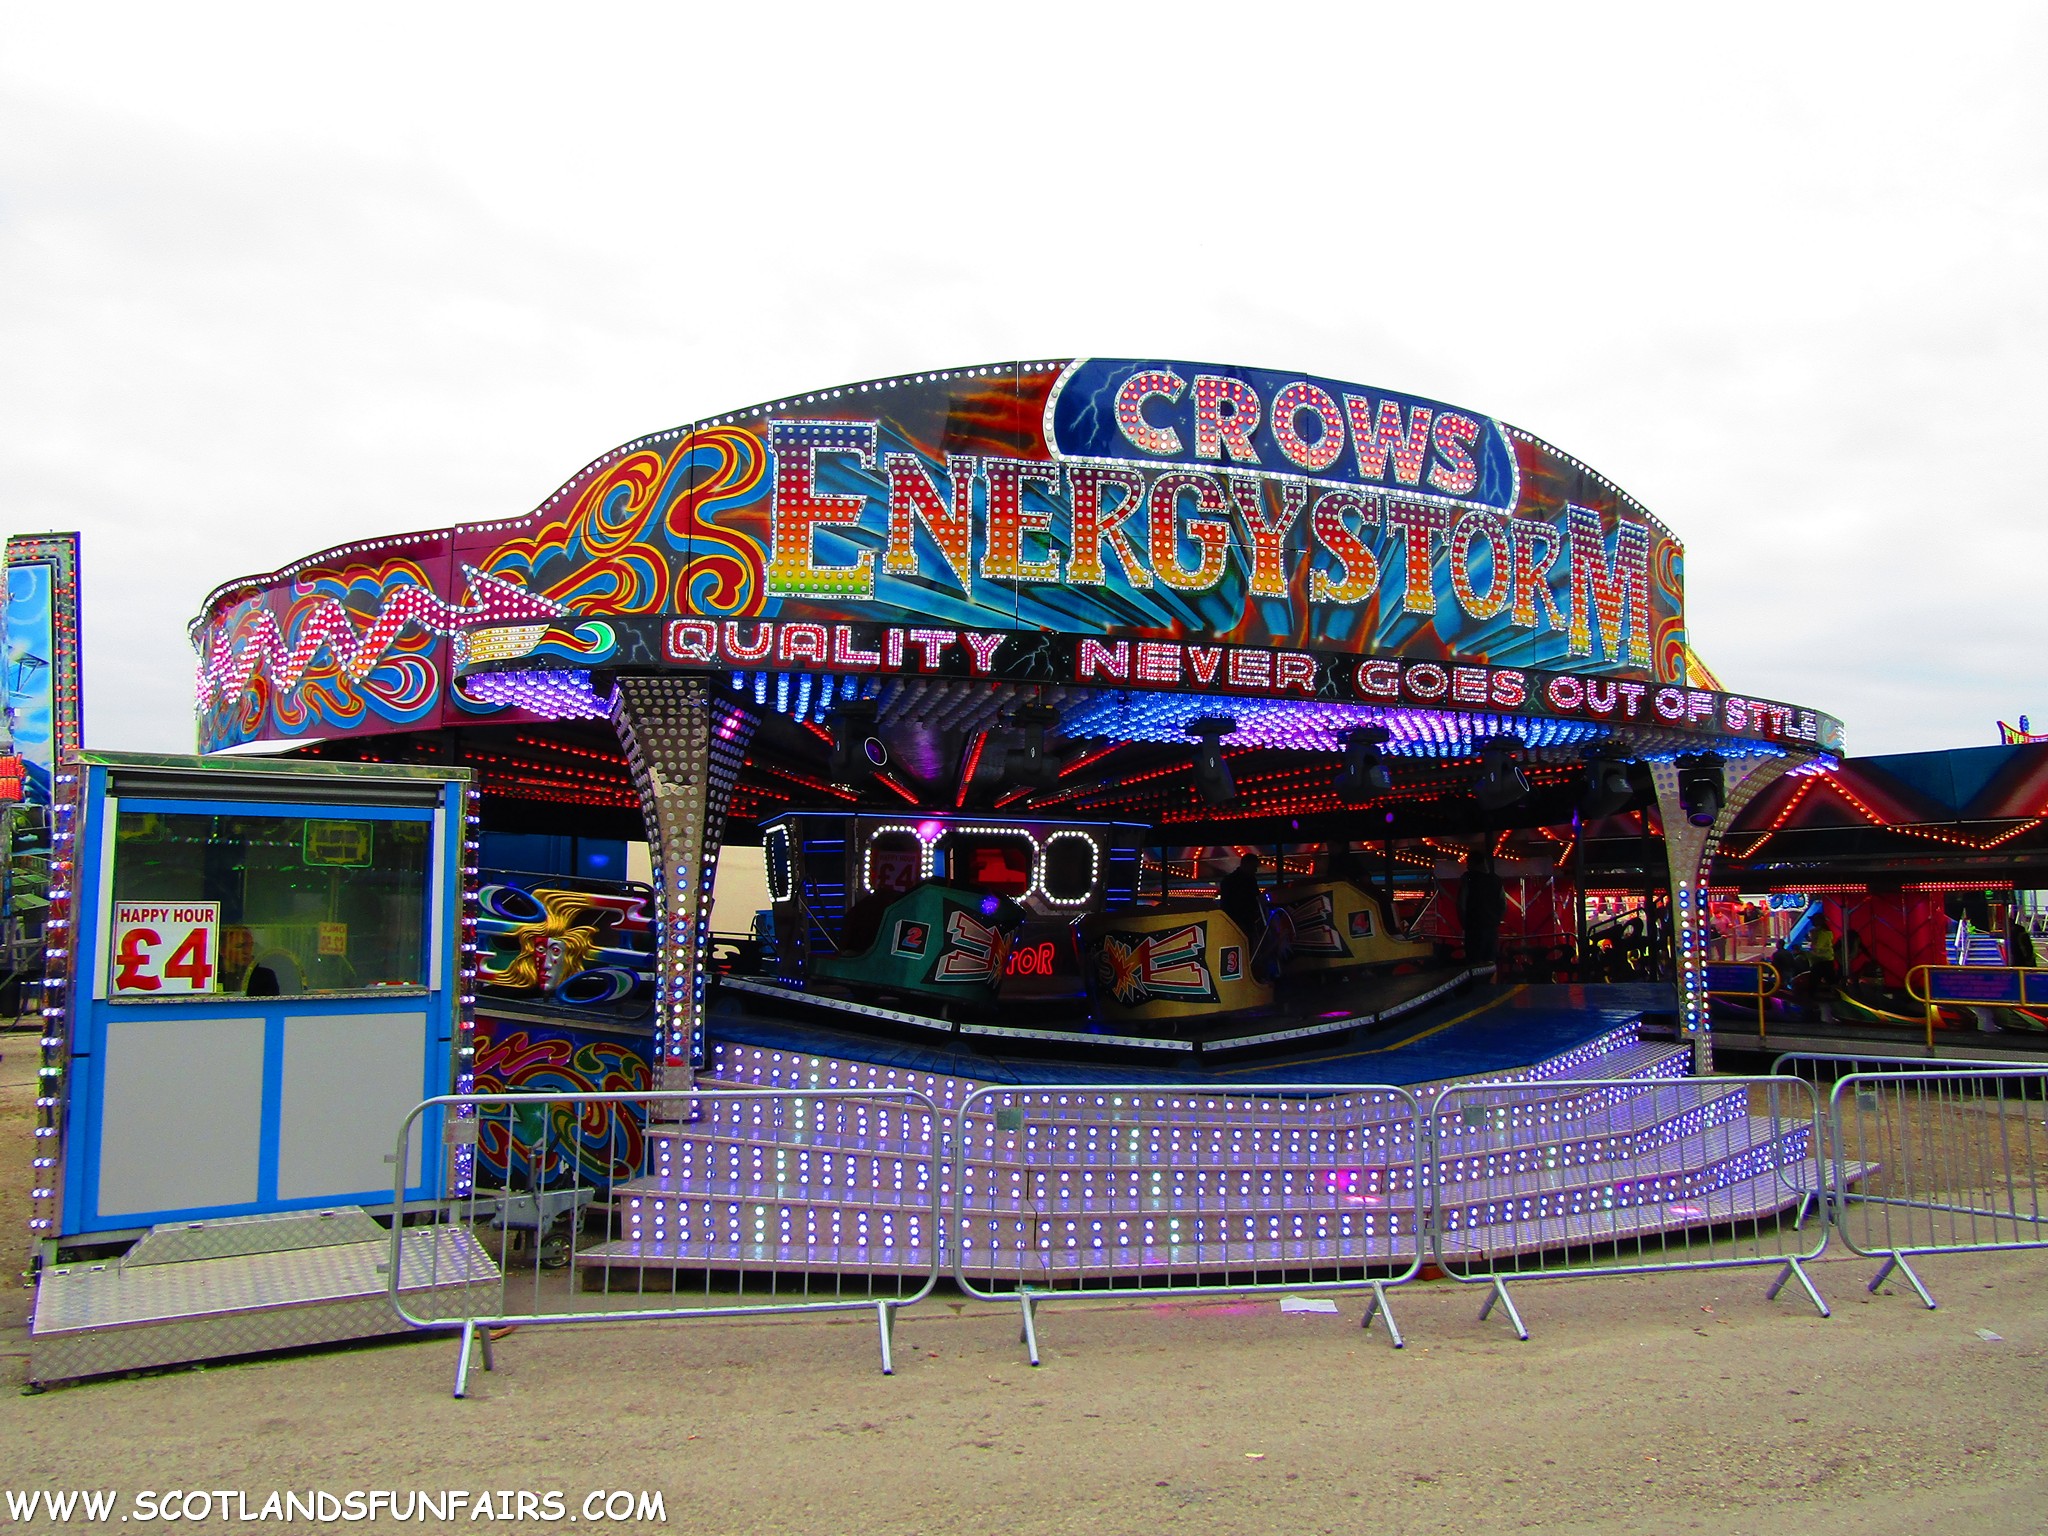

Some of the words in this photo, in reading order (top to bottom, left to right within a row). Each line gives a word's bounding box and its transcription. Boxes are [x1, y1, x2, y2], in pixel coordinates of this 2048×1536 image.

[1113, 369, 1479, 496] CROWS
[764, 418, 1654, 671] ENERGYSTORM
[668, 618, 1008, 672] QUALITY
[1080, 638, 1318, 691] NEVER
[1357, 659, 1527, 706] GOES
[1549, 675, 1646, 716] OUT
[1655, 687, 1713, 722] OF
[1725, 697, 1817, 742] STYLE
[115, 927, 213, 991] £4
[120, 908, 169, 923] HAPPY
[173, 908, 214, 923] HOUR
[902, 926, 922, 948] 2
